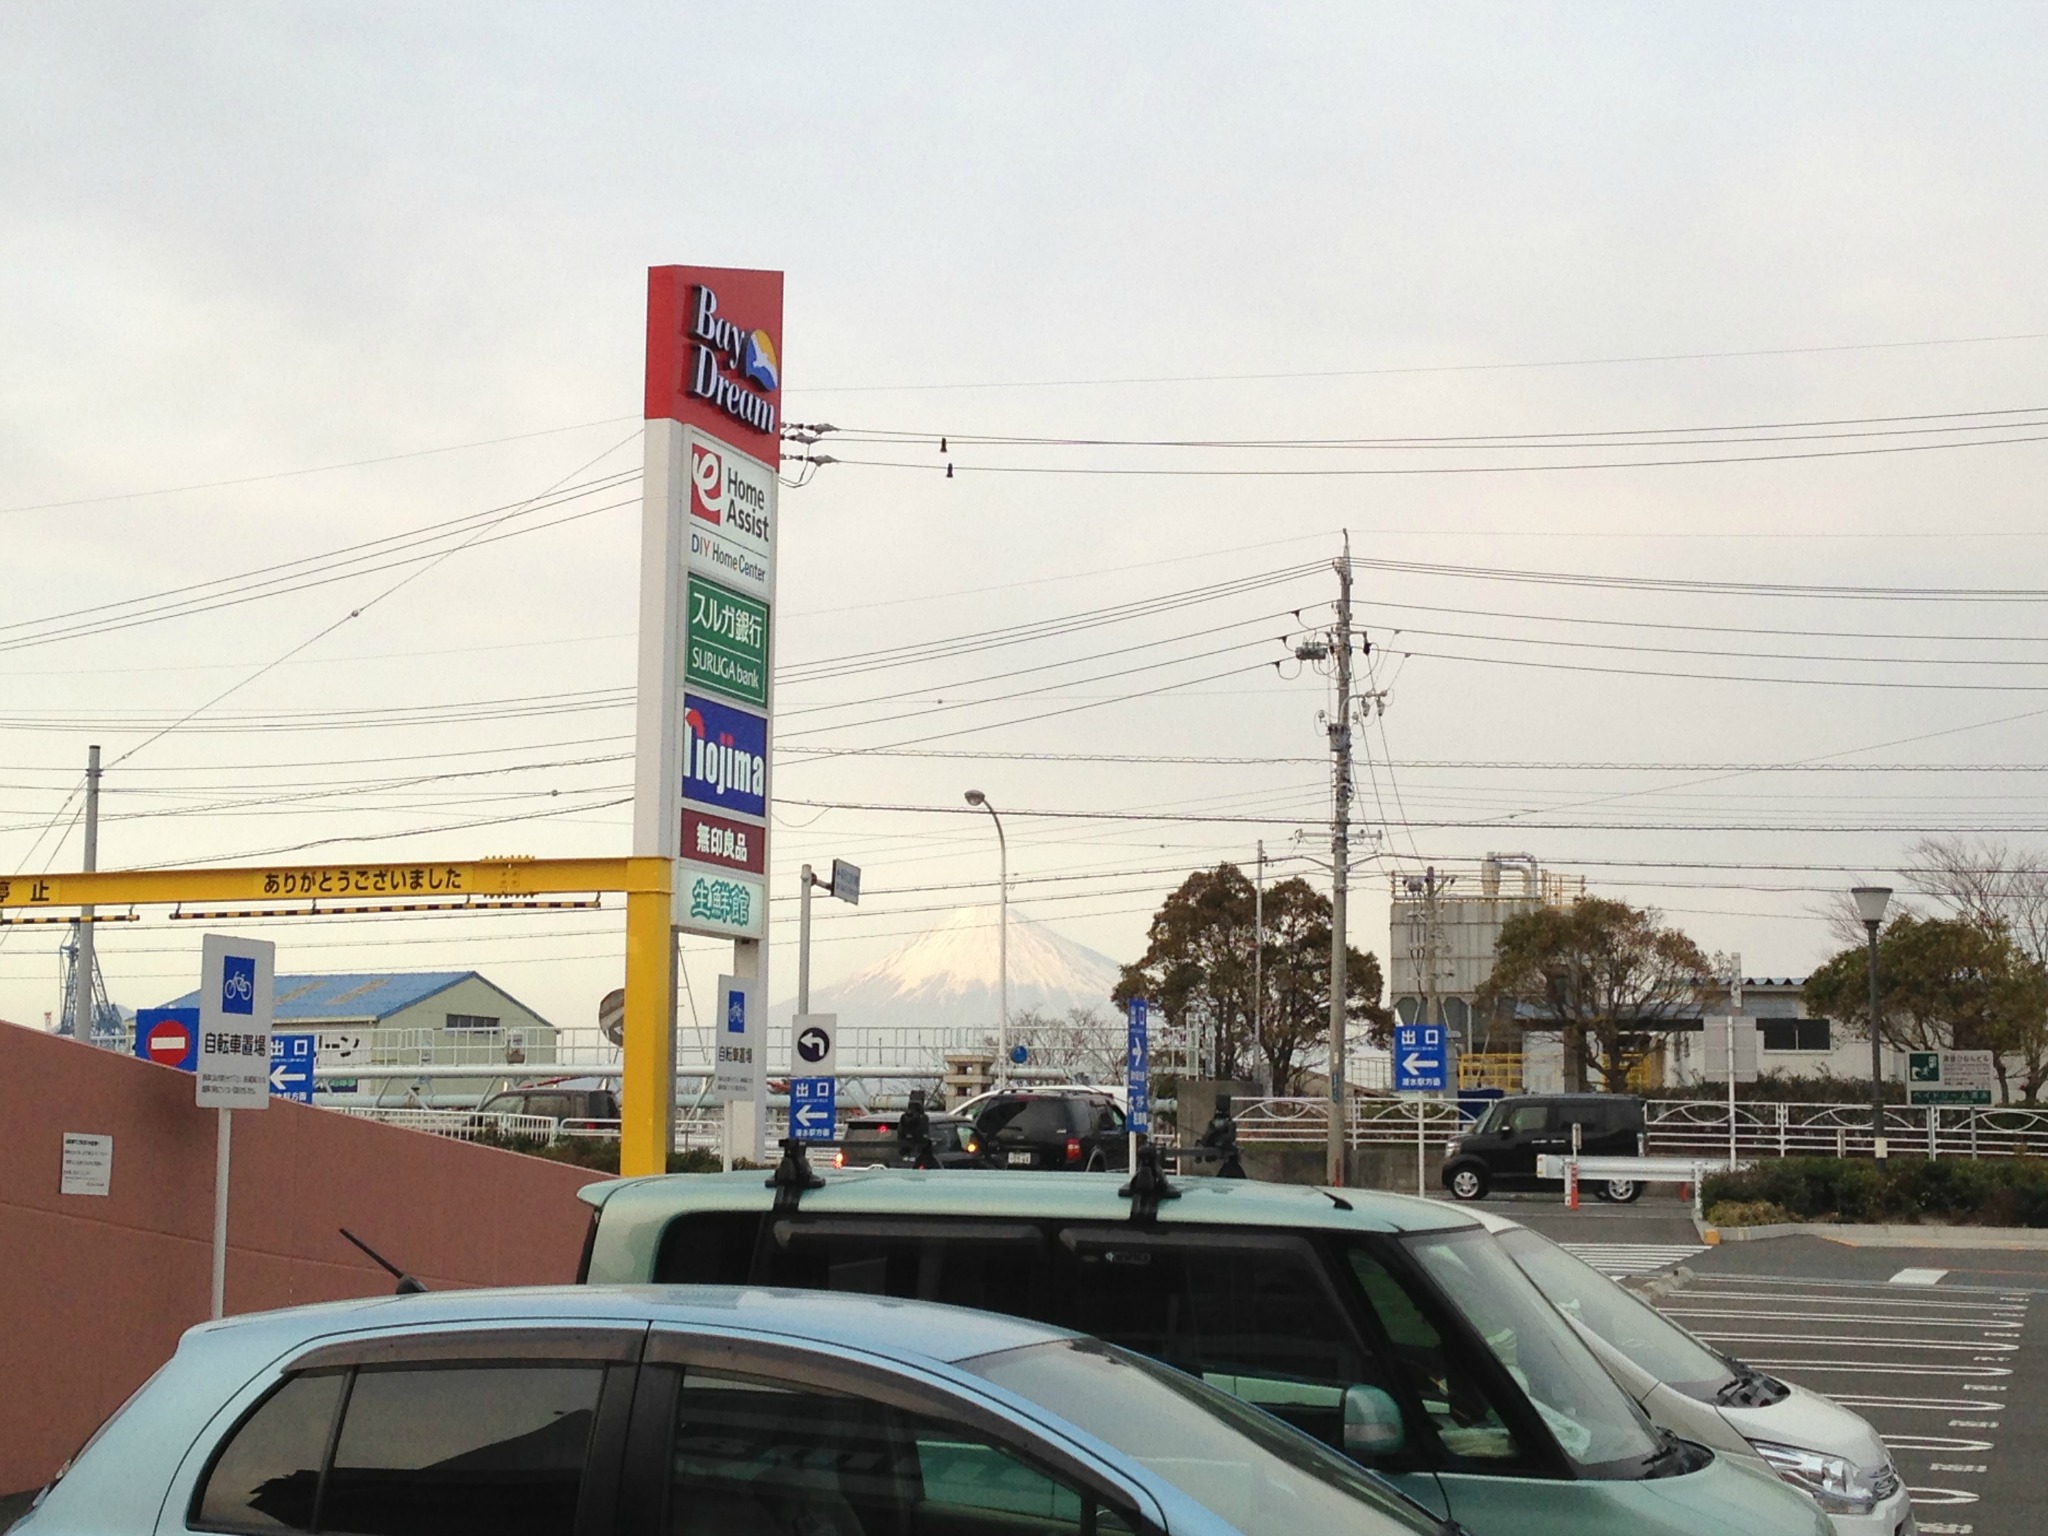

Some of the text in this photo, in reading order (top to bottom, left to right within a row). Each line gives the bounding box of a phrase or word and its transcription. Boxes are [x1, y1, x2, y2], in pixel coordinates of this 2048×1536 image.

[695, 284, 745, 369] Bay
[693, 344, 775, 433] Dream
[727, 467, 765, 510] Home
[726, 498, 769, 542] Assist
[691, 533, 766, 583] DIY Home Center
[692, 593, 763, 649] スルガ銀行
[692, 648, 760, 688] SURUGA bank
[696, 822, 748, 863] 無印良品
[264, 868, 462, 894] ありがとうございました
[690, 878, 750, 926] 生鮮館
[204, 1032, 267, 1057] 自転車置場
[270, 1039, 308, 1056] 出口
[1401, 1029, 1439, 1044] 出口
[795, 1082, 829, 1097] 出口
